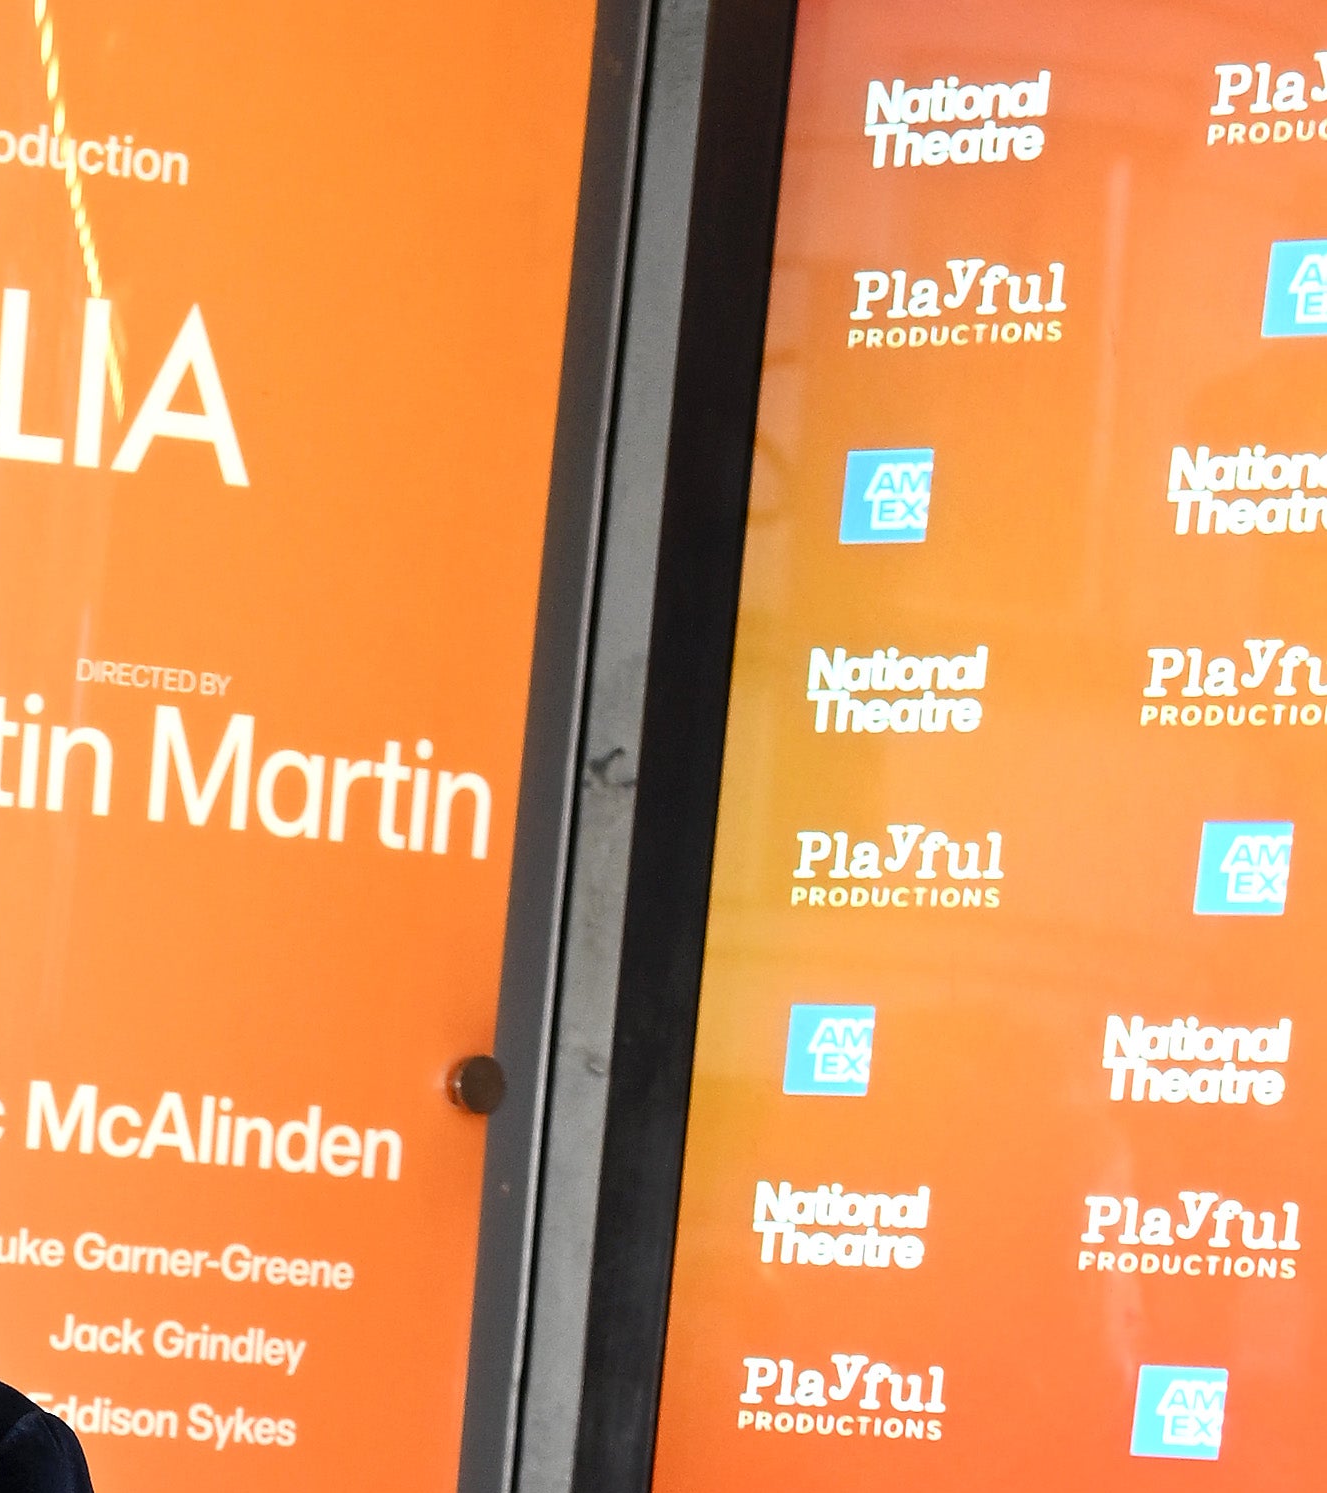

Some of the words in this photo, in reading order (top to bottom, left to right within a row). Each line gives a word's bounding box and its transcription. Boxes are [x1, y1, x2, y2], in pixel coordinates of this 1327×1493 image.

[866, 70, 1051, 126] National
[865, 120, 1044, 168] Theatre
[850, 259, 1066, 319] Playful
[848, 321, 1061, 347] PRODUCTIONS
[75, 657, 197, 693] DIRECTED
[198, 671, 232, 696] BY
[807, 645, 988, 697] National
[807, 690, 982, 732] Theatre
[1141, 704, 1327, 725] PRODUCTIO
[148, 705, 492, 860] Martin
[794, 824, 1004, 879] Playful
[792, 887, 999, 907] PRODUCTIONS
[1103, 1015, 1292, 1068] National
[1103, 1059, 1287, 1105] Theatre
[26, 1080, 401, 1180] McAlinden
[753, 1181, 930, 1233] National
[1081, 1191, 1301, 1251] Playful
[74, 1232, 354, 1289] Garner-Greene
[753, 1224, 927, 1268] Theatre
[1078, 1251, 1296, 1279] PRODUCTIONS
[50, 1314, 143, 1354] Jack
[153, 1320, 305, 1375] Grindley
[739, 1354, 945, 1413] Playful
[187, 1403, 295, 1450] Sykes
[737, 1410, 942, 1441] PRODUCTIONS
